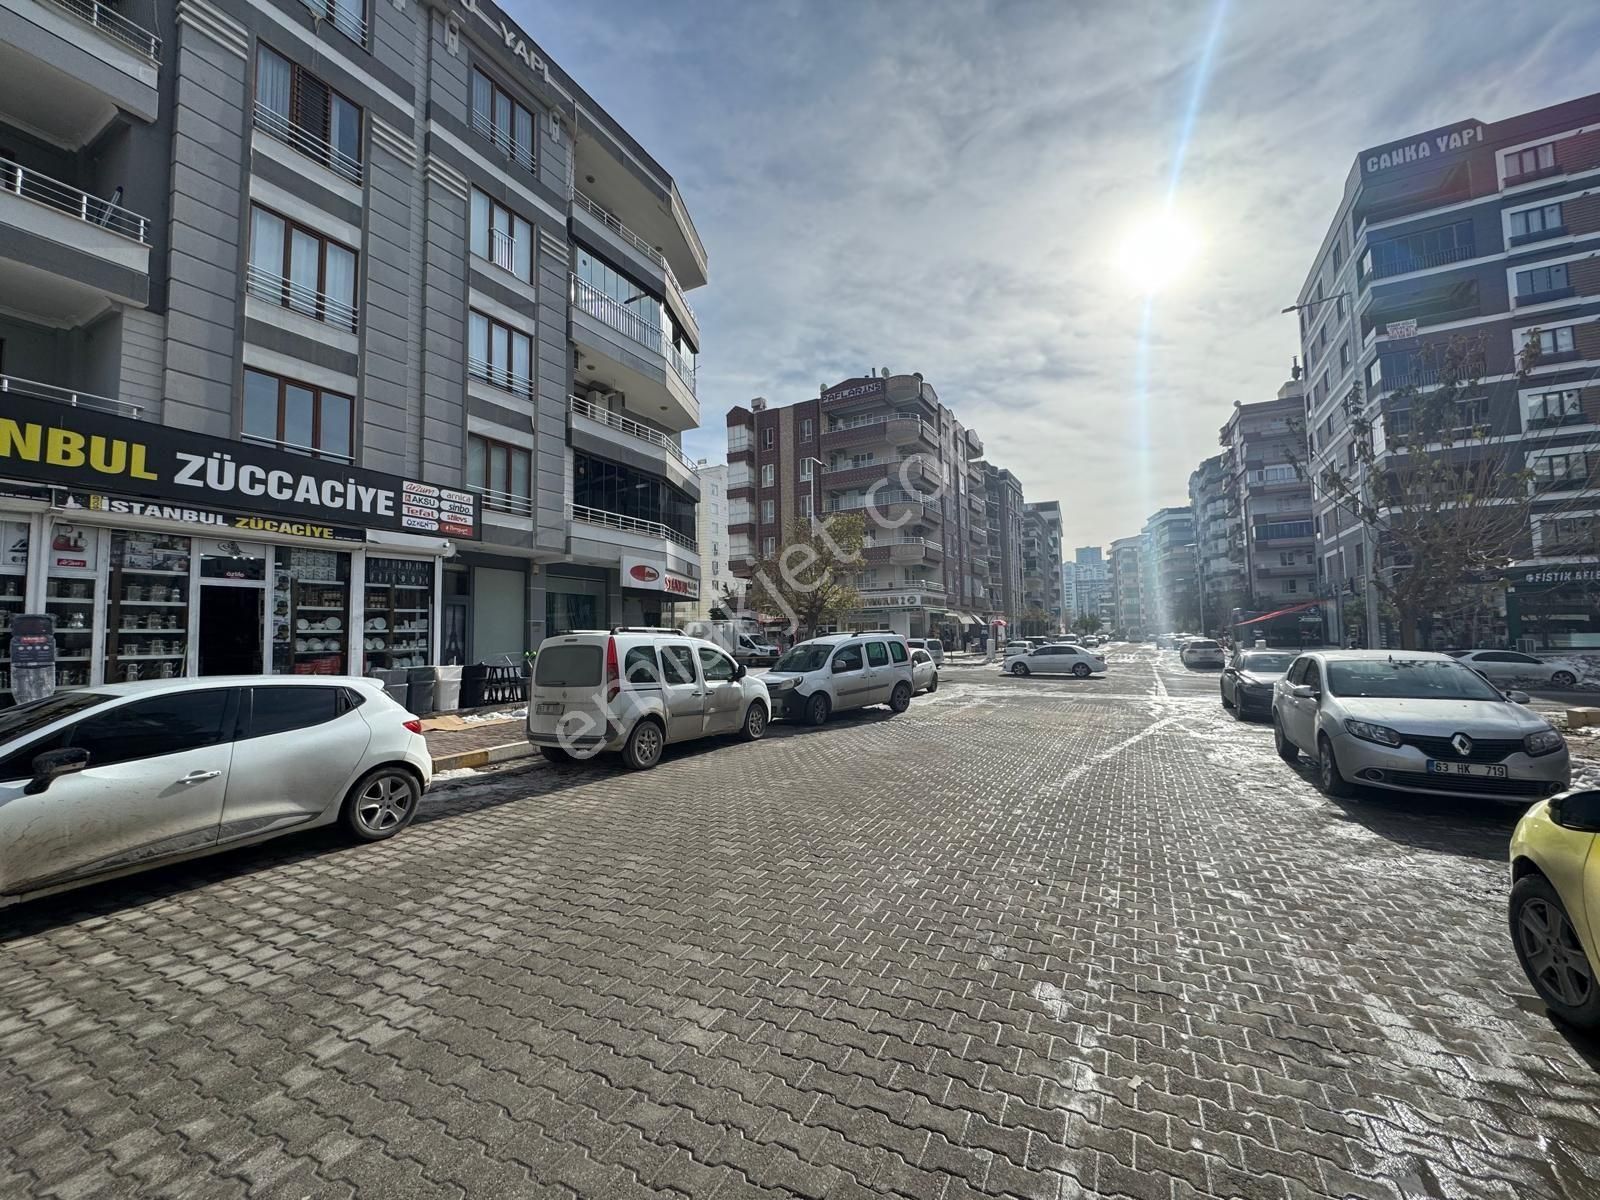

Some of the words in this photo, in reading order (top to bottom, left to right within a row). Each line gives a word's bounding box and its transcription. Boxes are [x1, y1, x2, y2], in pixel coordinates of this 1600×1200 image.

[500, 20, 549, 83] YAPI
[1436, 126, 1484, 153] YAPI
[174, 452, 395, 517] ZÜCCACİYE
[412, 495, 436, 507] AKSU
[100, 496, 229, 526] İSTANBUL
[235, 517, 334, 540] ZÜCACİYE
[406, 506, 436, 519] Tefal
[1535, 571, 1572, 582] FISTIK
[1435, 762, 1449, 772] 63
[1457, 764, 1471, 774] HK
[1484, 765, 1504, 777] 719
